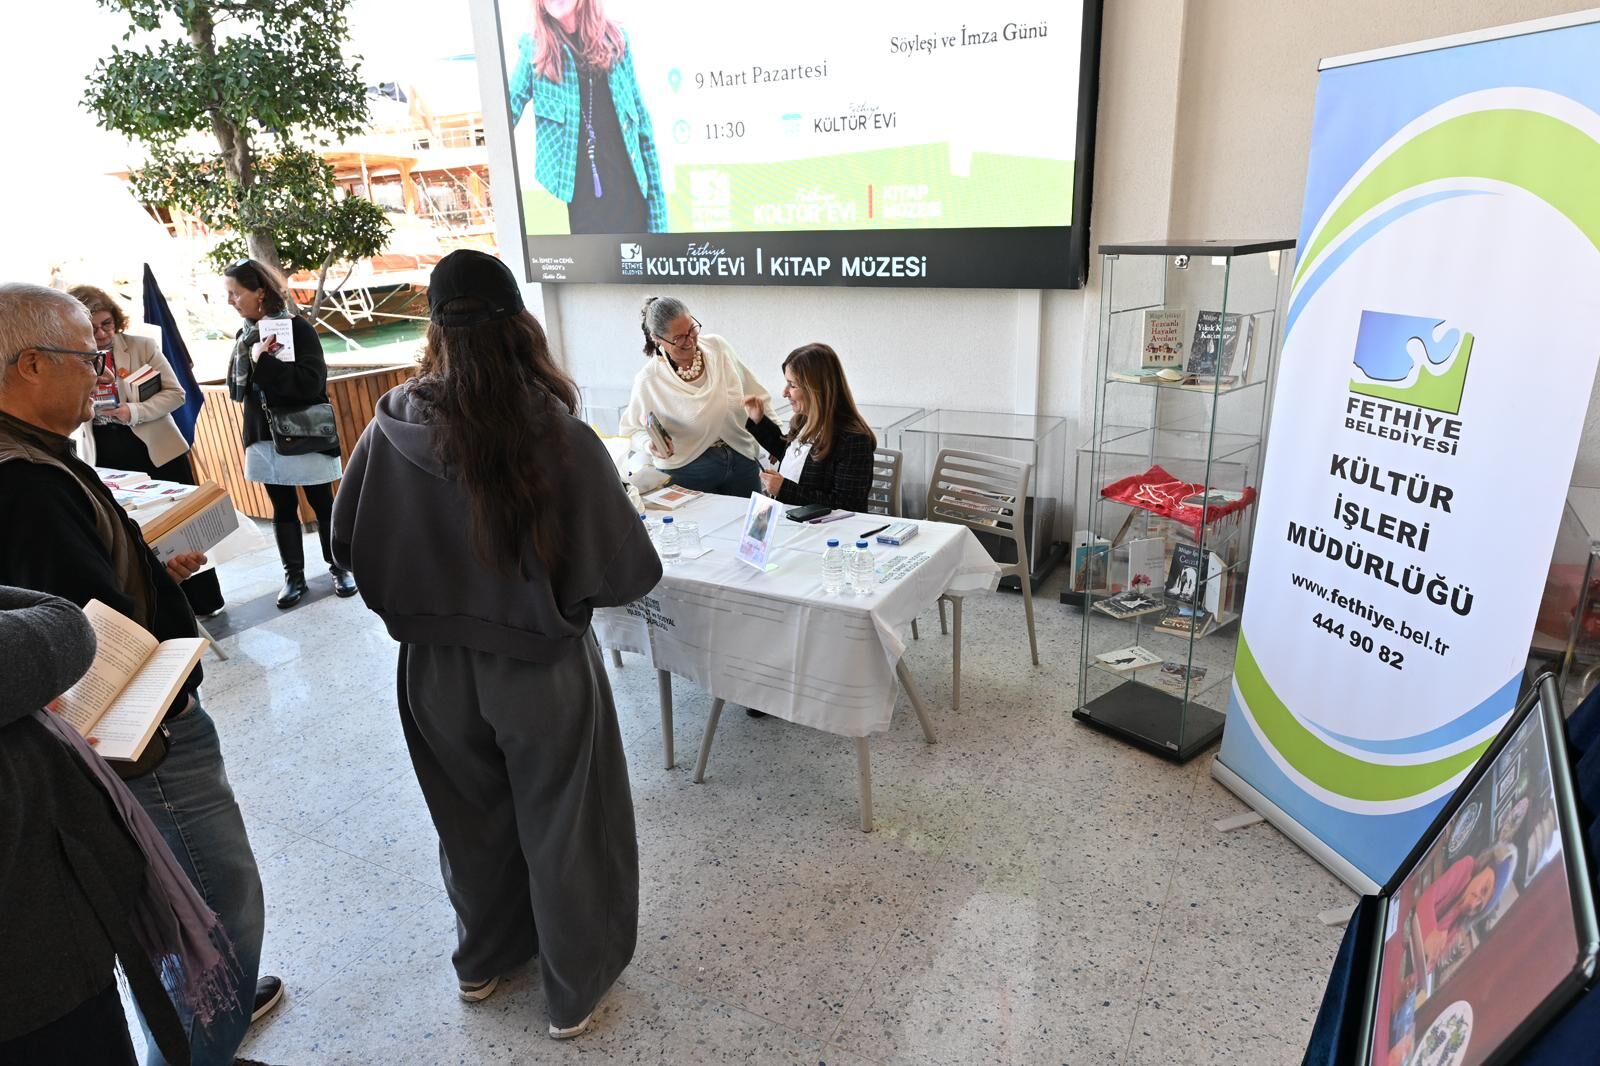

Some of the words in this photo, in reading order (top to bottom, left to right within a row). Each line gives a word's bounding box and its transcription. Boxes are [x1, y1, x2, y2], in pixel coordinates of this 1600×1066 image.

[890, 32, 937, 57] Söyleşi
[941, 36, 956, 48] ve
[961, 24, 998, 46] İmza
[1002, 21, 1048, 41] Günü
[695, 73, 704, 89] 9
[710, 70, 747, 88] Mart
[752, 60, 828, 84] Pazartesi
[706, 121, 745, 140] 11:30
[814, 113, 867, 133] KÜLTÜR
[646, 256, 711, 276] KÜLTÜR
[1344, 417, 1458, 456] BELEDİYESİ
[1346, 397, 1463, 440] FETHİYE
[1330, 453, 1454, 513] KÜLTÜR
[1333, 492, 1430, 552] İŞLERİ
[1287, 521, 1474, 617] MÜDÜRLÜĞÜ
[1292, 573, 1450, 656] www.fethiye.bel.tr
[1312, 612, 1345, 640] 444
[1349, 630, 1374, 654] 90
[1378, 645, 1404, 670] 82
